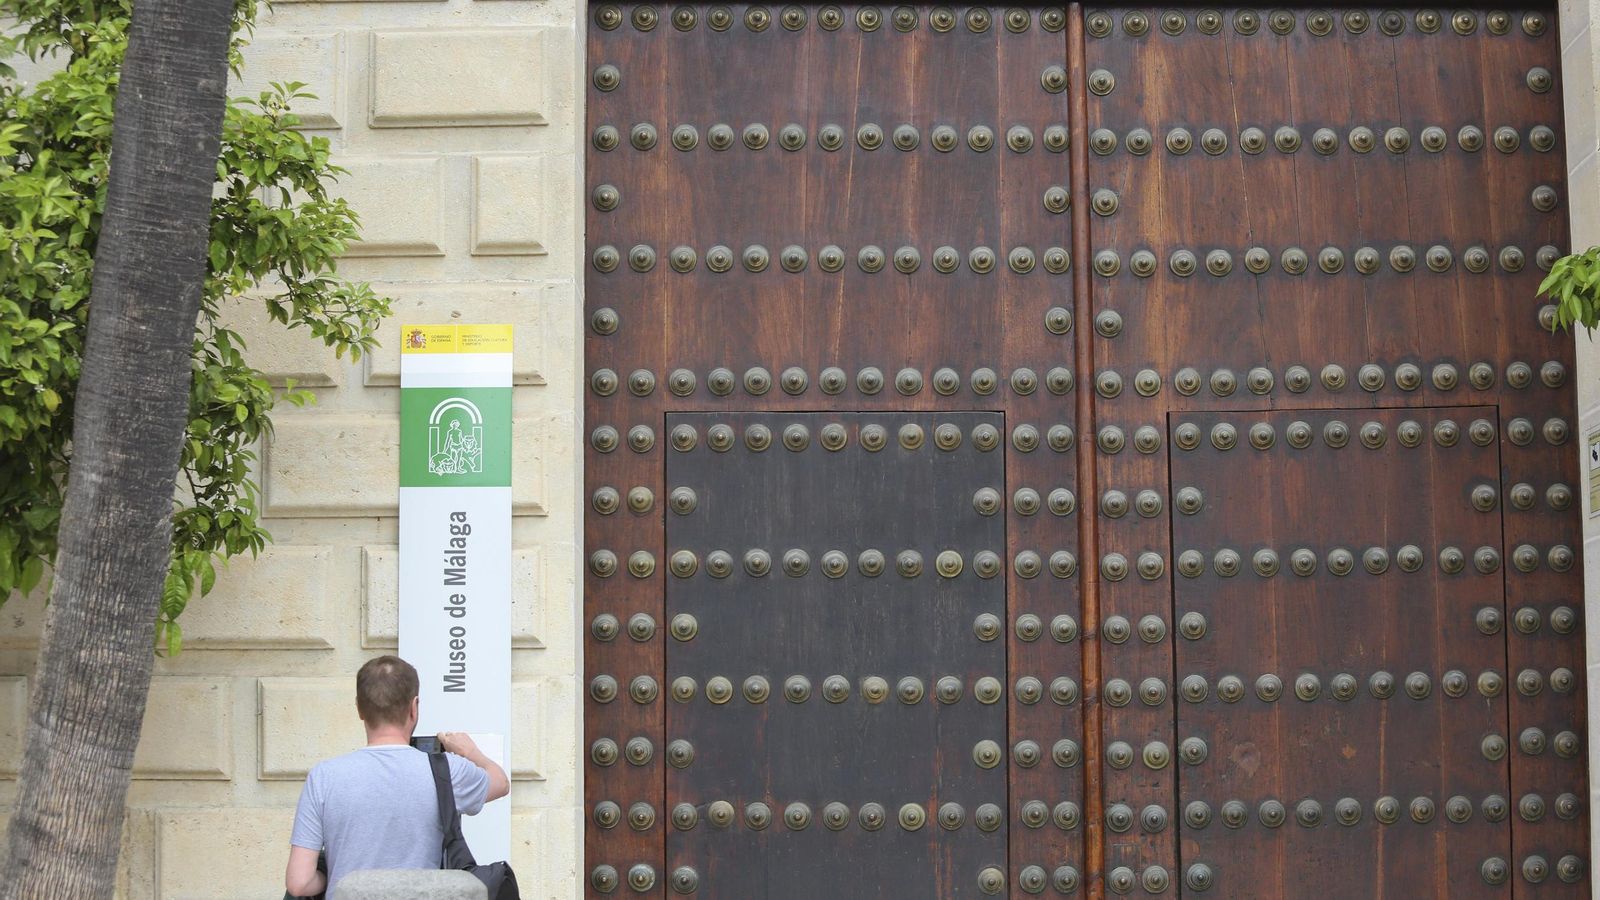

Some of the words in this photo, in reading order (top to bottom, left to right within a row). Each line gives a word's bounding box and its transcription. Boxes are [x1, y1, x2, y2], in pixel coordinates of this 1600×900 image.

[443, 512, 471, 585] Málaga
[443, 594, 466, 618] de
[443, 626, 466, 692] Museo
